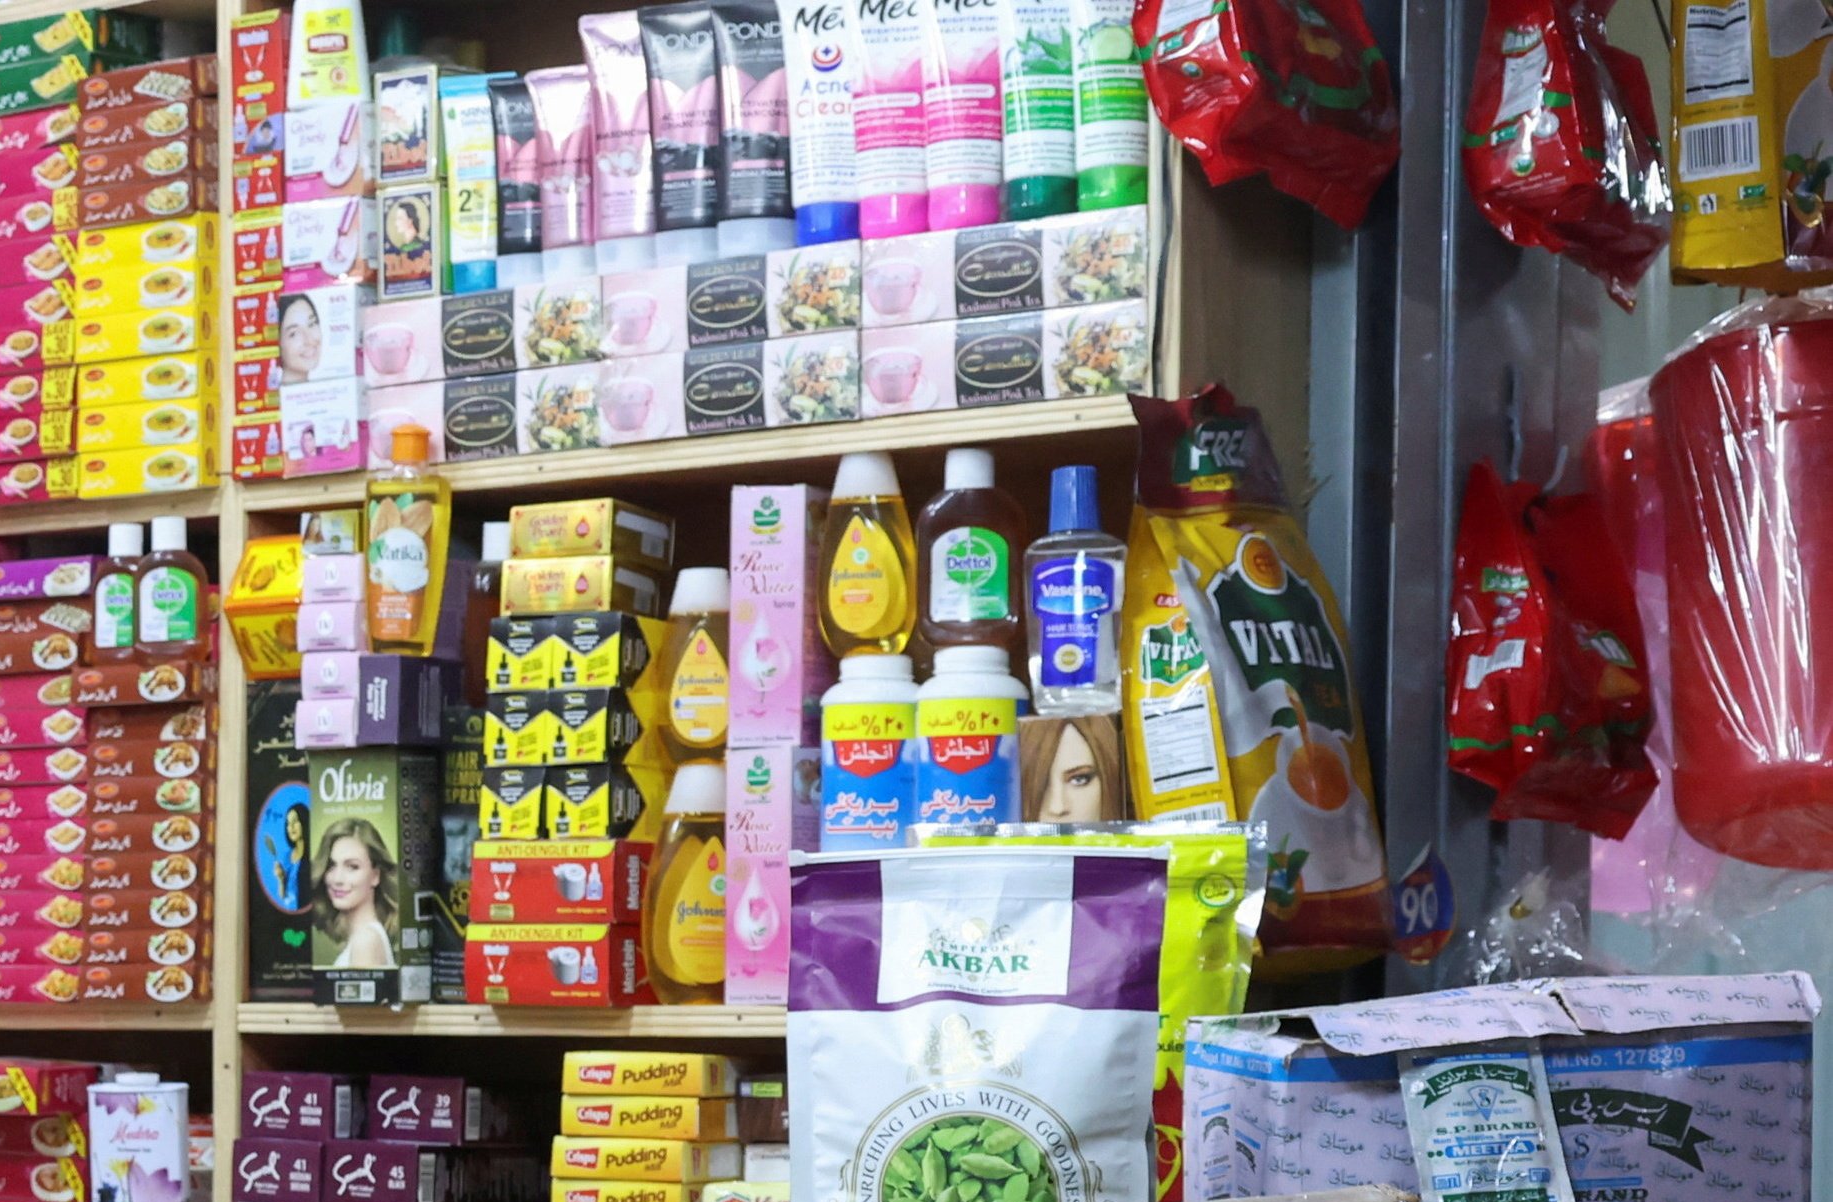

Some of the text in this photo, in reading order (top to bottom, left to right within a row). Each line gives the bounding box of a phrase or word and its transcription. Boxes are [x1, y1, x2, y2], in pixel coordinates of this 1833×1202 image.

[375, 542, 423, 562] Vatika
[946, 554, 992, 570] Dettol
[742, 576, 795, 596] Water
[1230, 618, 1334, 669] VITAL
[319, 759, 385, 803] Olivia
[496, 843, 590, 857] ANTI-DENGUE KIT
[1400, 887, 1437, 933] 90
[489, 926, 584, 940] ANTI-DENGUE KIT
[918, 949, 1031, 974] AKBAR
[622, 1062, 687, 1084] Pudding
[619, 1105, 682, 1126] Pudding
[908, 1090, 966, 1119] LIVES
[977, 1090, 1032, 1122] WITH
[605, 1147, 668, 1168] Pudding
